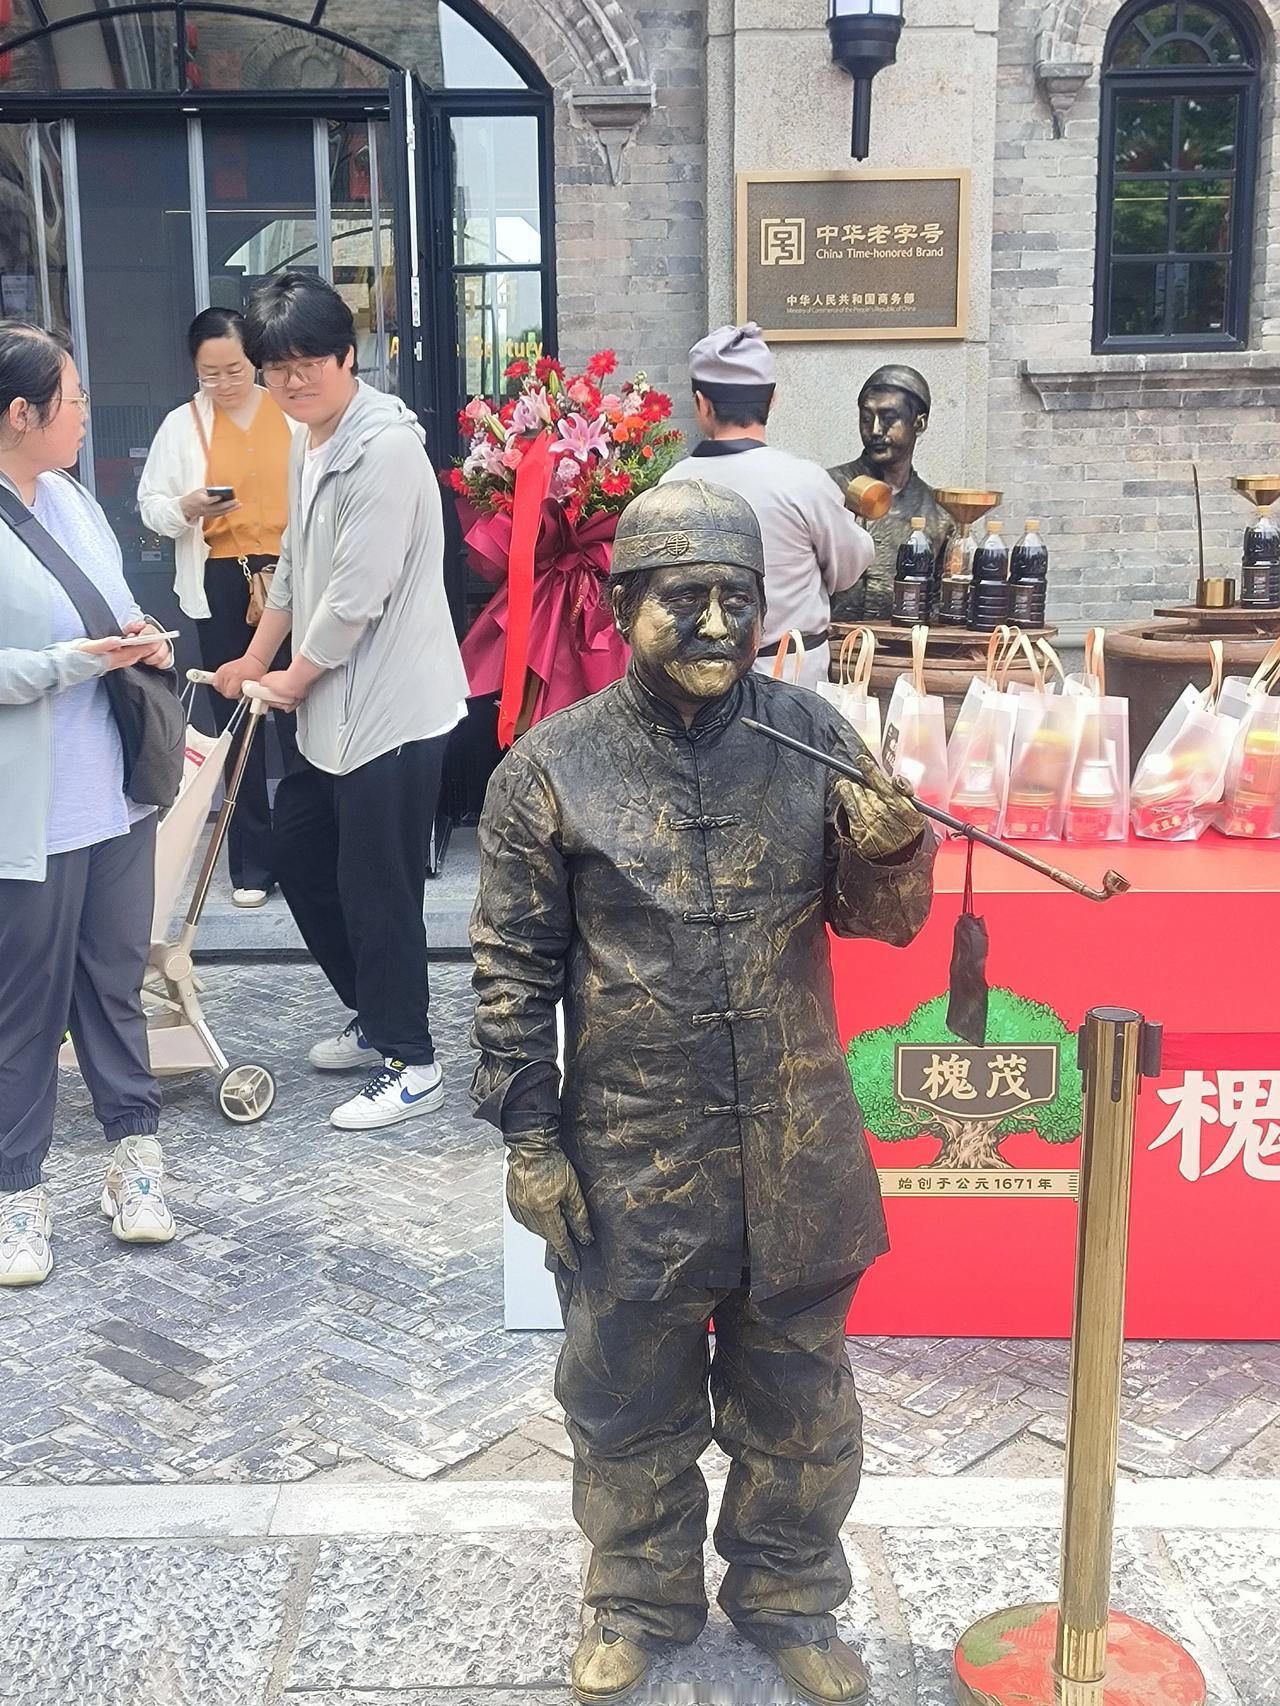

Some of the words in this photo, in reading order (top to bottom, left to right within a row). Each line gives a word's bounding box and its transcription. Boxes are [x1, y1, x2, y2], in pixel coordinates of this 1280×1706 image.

[816, 223, 944, 245] 中华老字号
[816, 248, 843, 259] China
[847, 247, 913, 259] Time-honored
[915, 247, 944, 258] Brand
[786, 292, 916, 307] 中华人民共和国商务部
[921, 1053, 1031, 1101] 槐茂
[1147, 1070, 1280, 1183] 槐
[898, 1177, 1053, 1190] 始创于公元1671年
